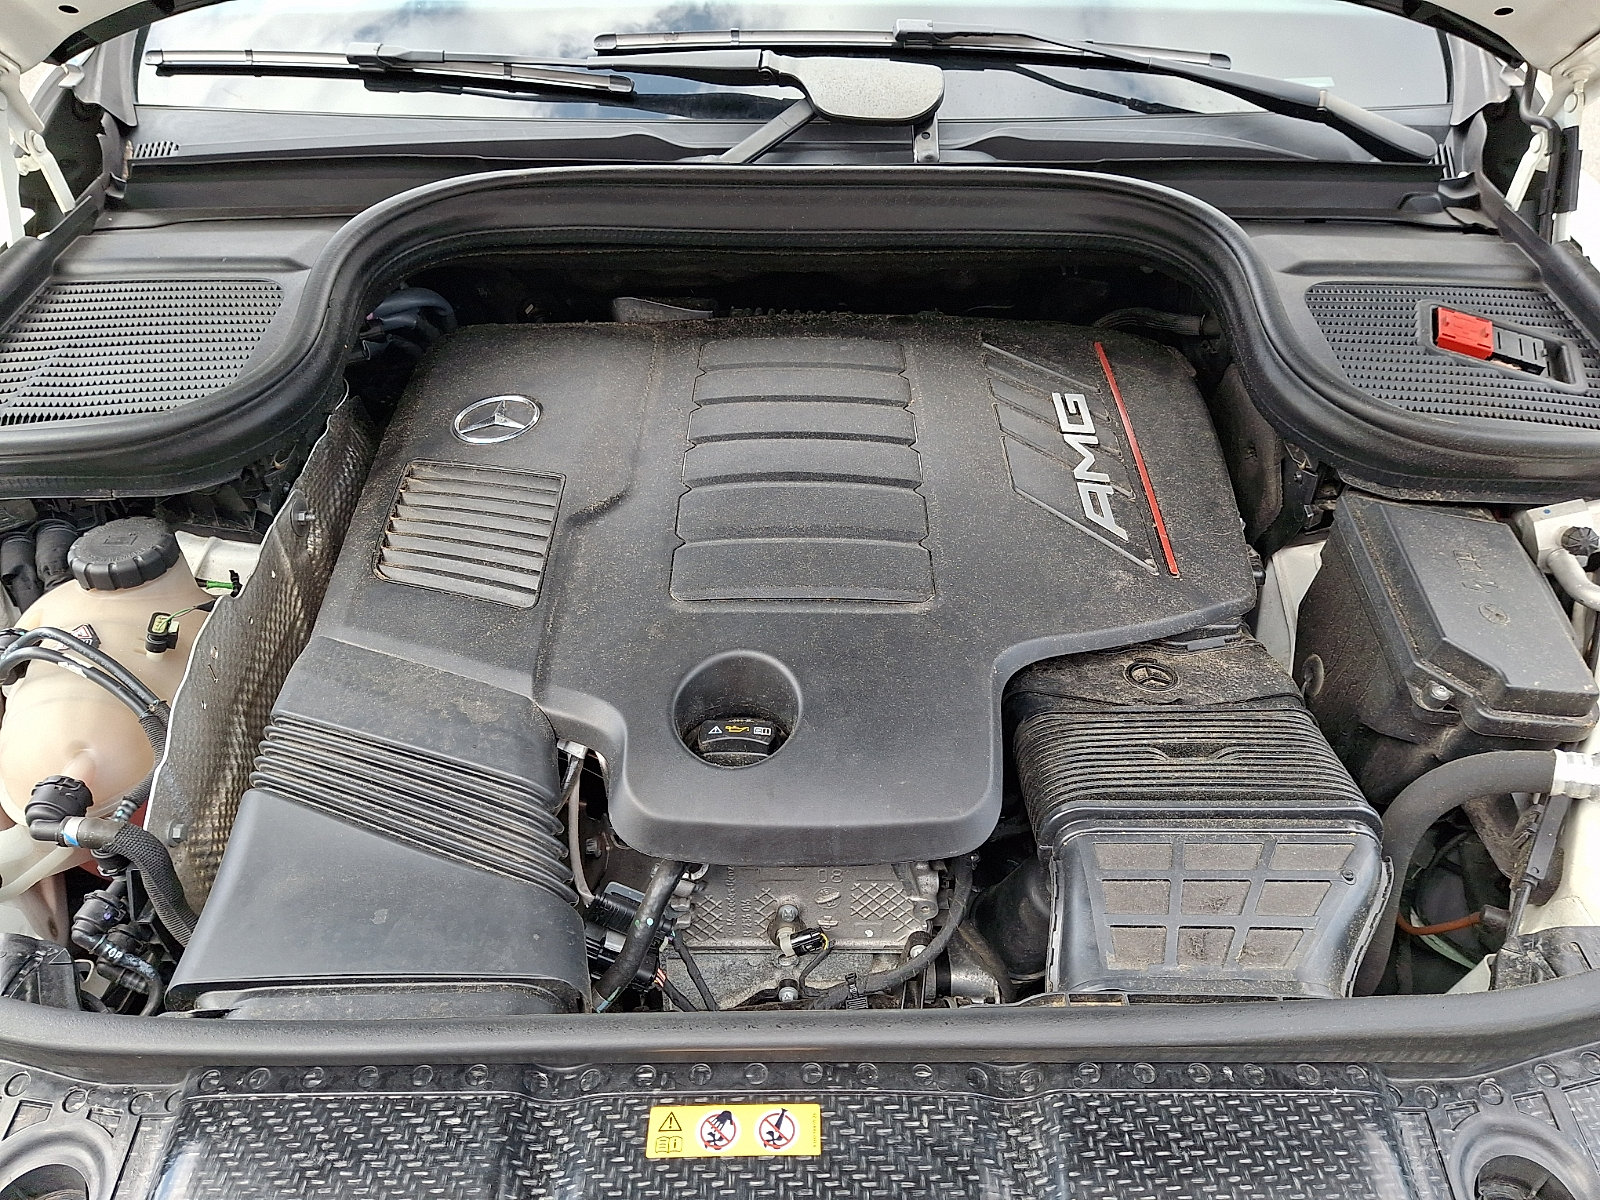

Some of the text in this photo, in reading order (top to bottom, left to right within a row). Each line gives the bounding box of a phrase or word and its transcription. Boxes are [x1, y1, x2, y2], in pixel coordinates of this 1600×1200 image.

[1051, 392, 1129, 542] AMG
[817, 868, 843, 883] 08
[104, 943, 124, 959] TOP
